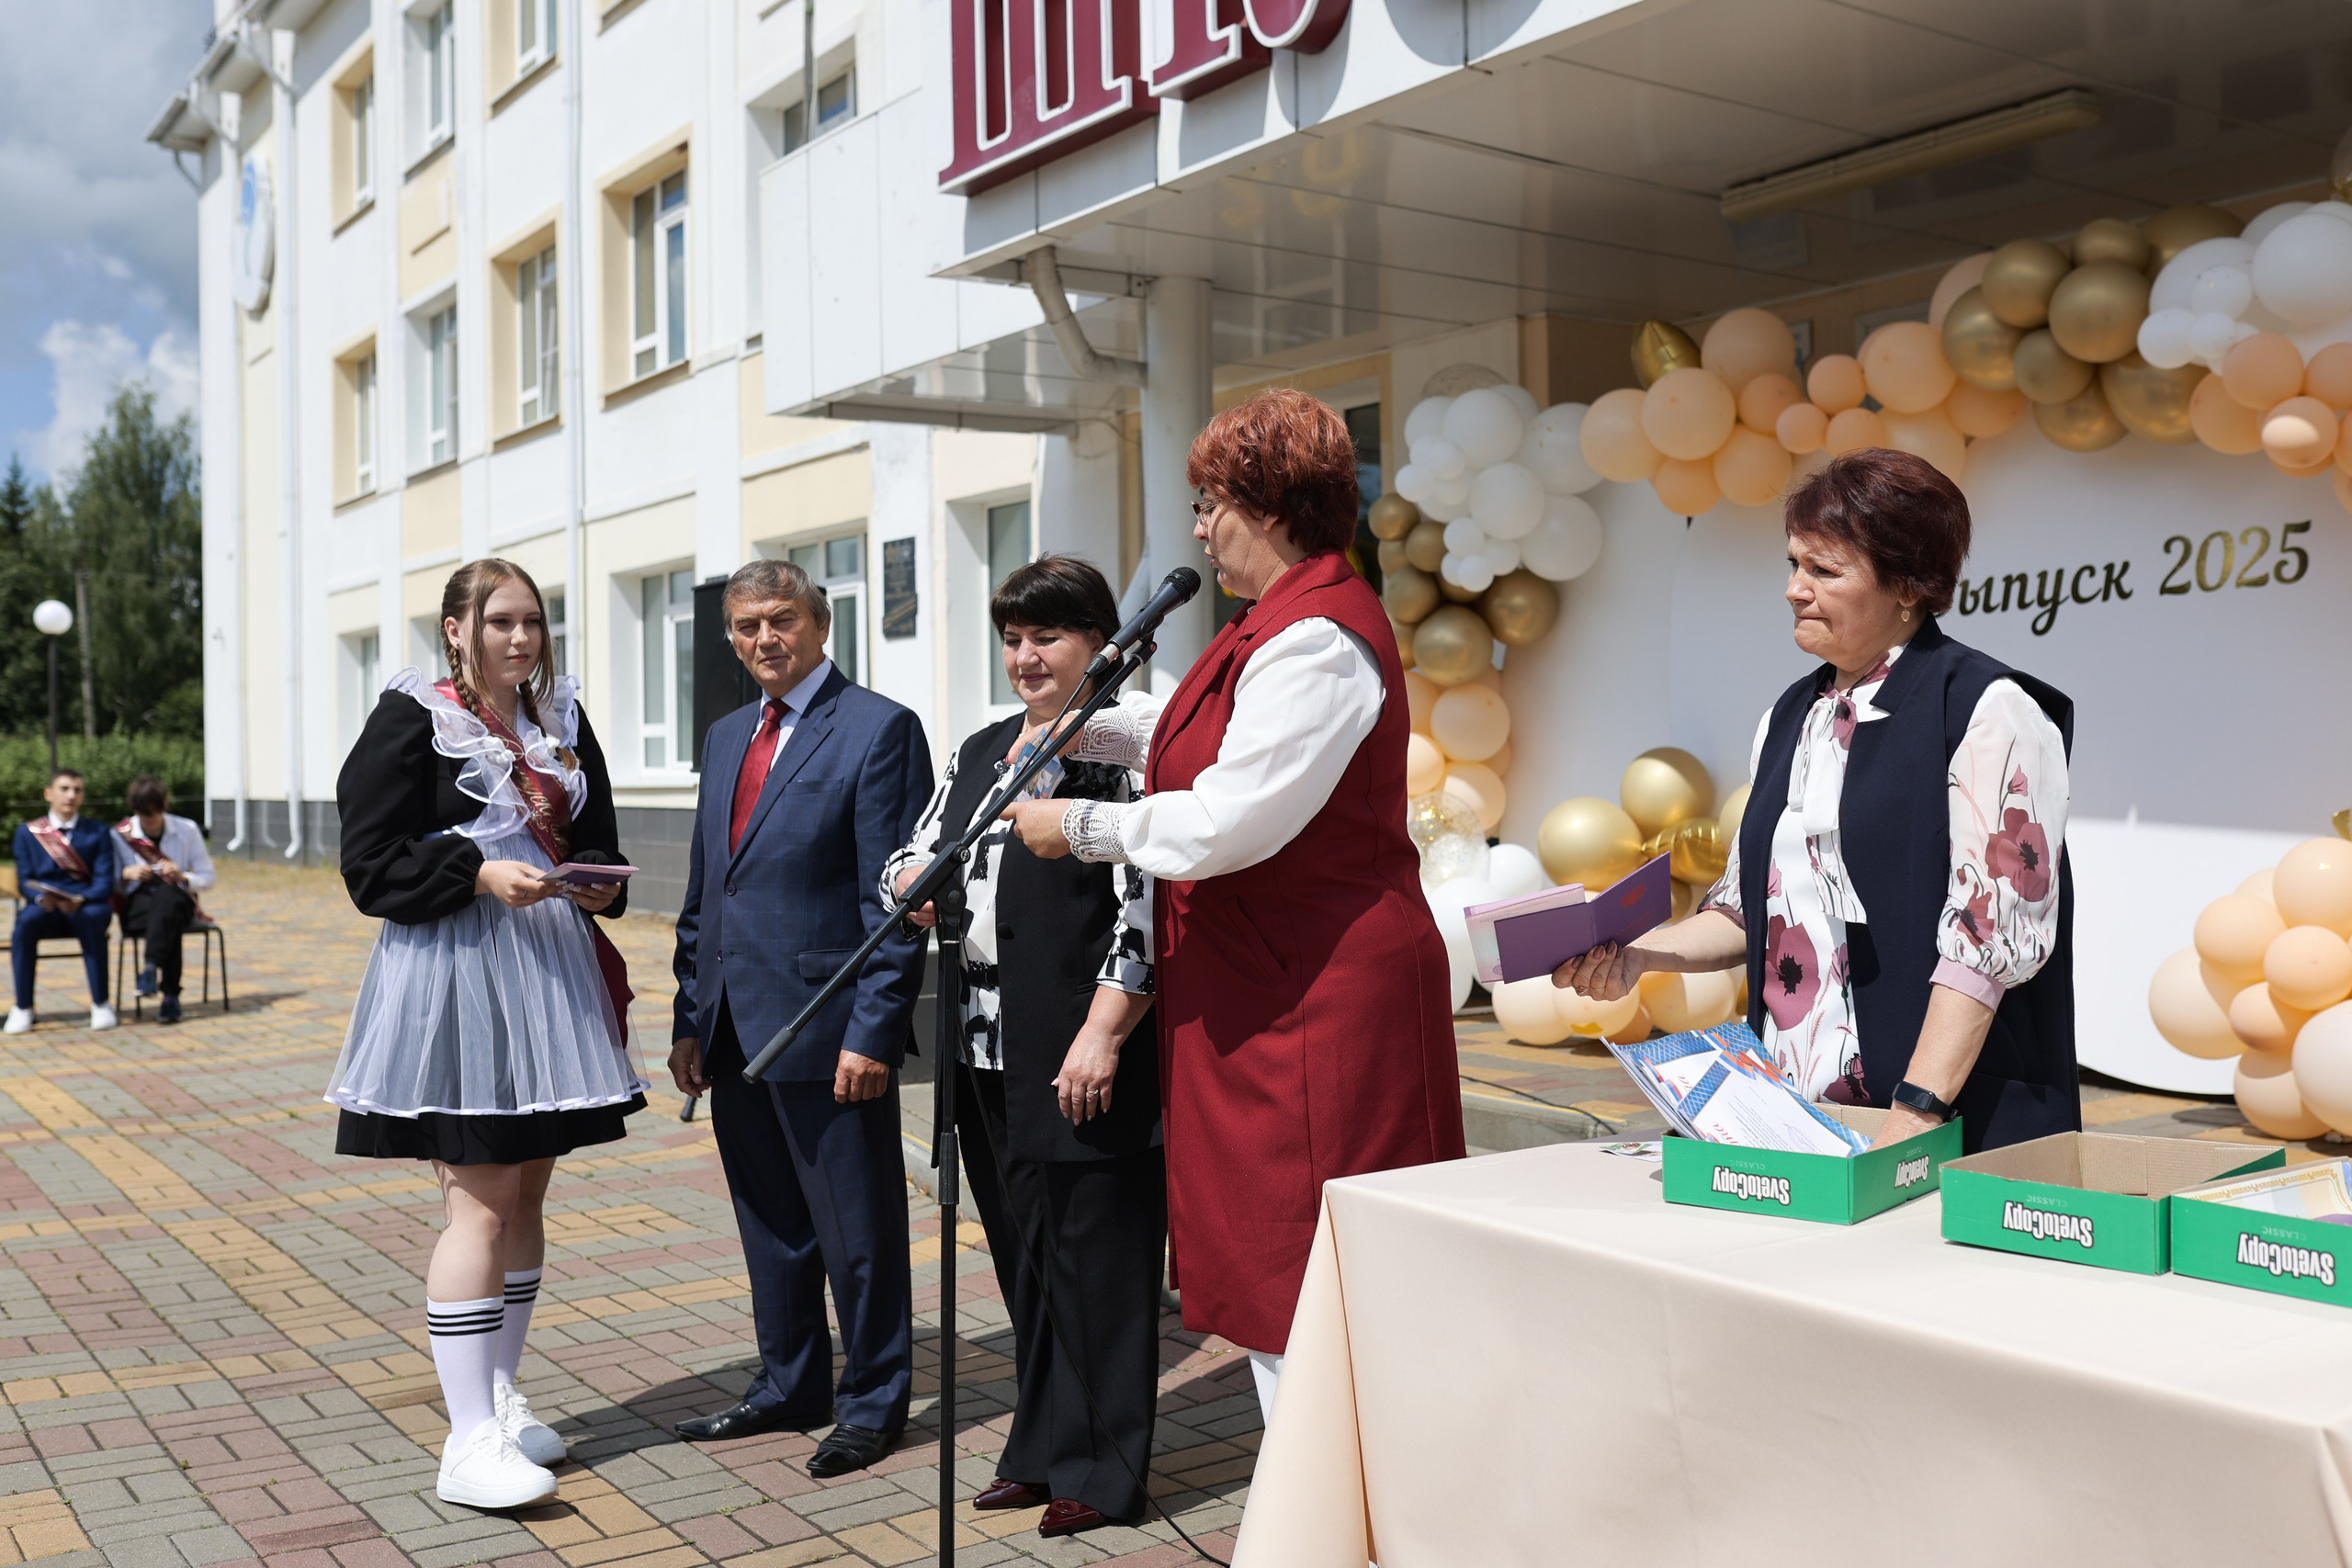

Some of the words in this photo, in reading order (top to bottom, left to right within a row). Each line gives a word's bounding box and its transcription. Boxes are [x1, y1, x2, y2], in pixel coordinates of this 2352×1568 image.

[1937, 561, 2134, 636] ыпуск
[2159, 520, 2312, 596] 2025
[1729, 1159, 1766, 1170] CLASSIC
[1894, 1155, 1929, 1189] SvetoCopy
[1712, 1165, 1791, 1206] SvetoCopy
[2026, 1195, 2068, 1208] CLASSIC
[2003, 1201, 2094, 1248] SvetoCopy
[2261, 1226, 2307, 1241] CLASSIC
[2236, 1232, 2335, 1287] SvetoCopy
